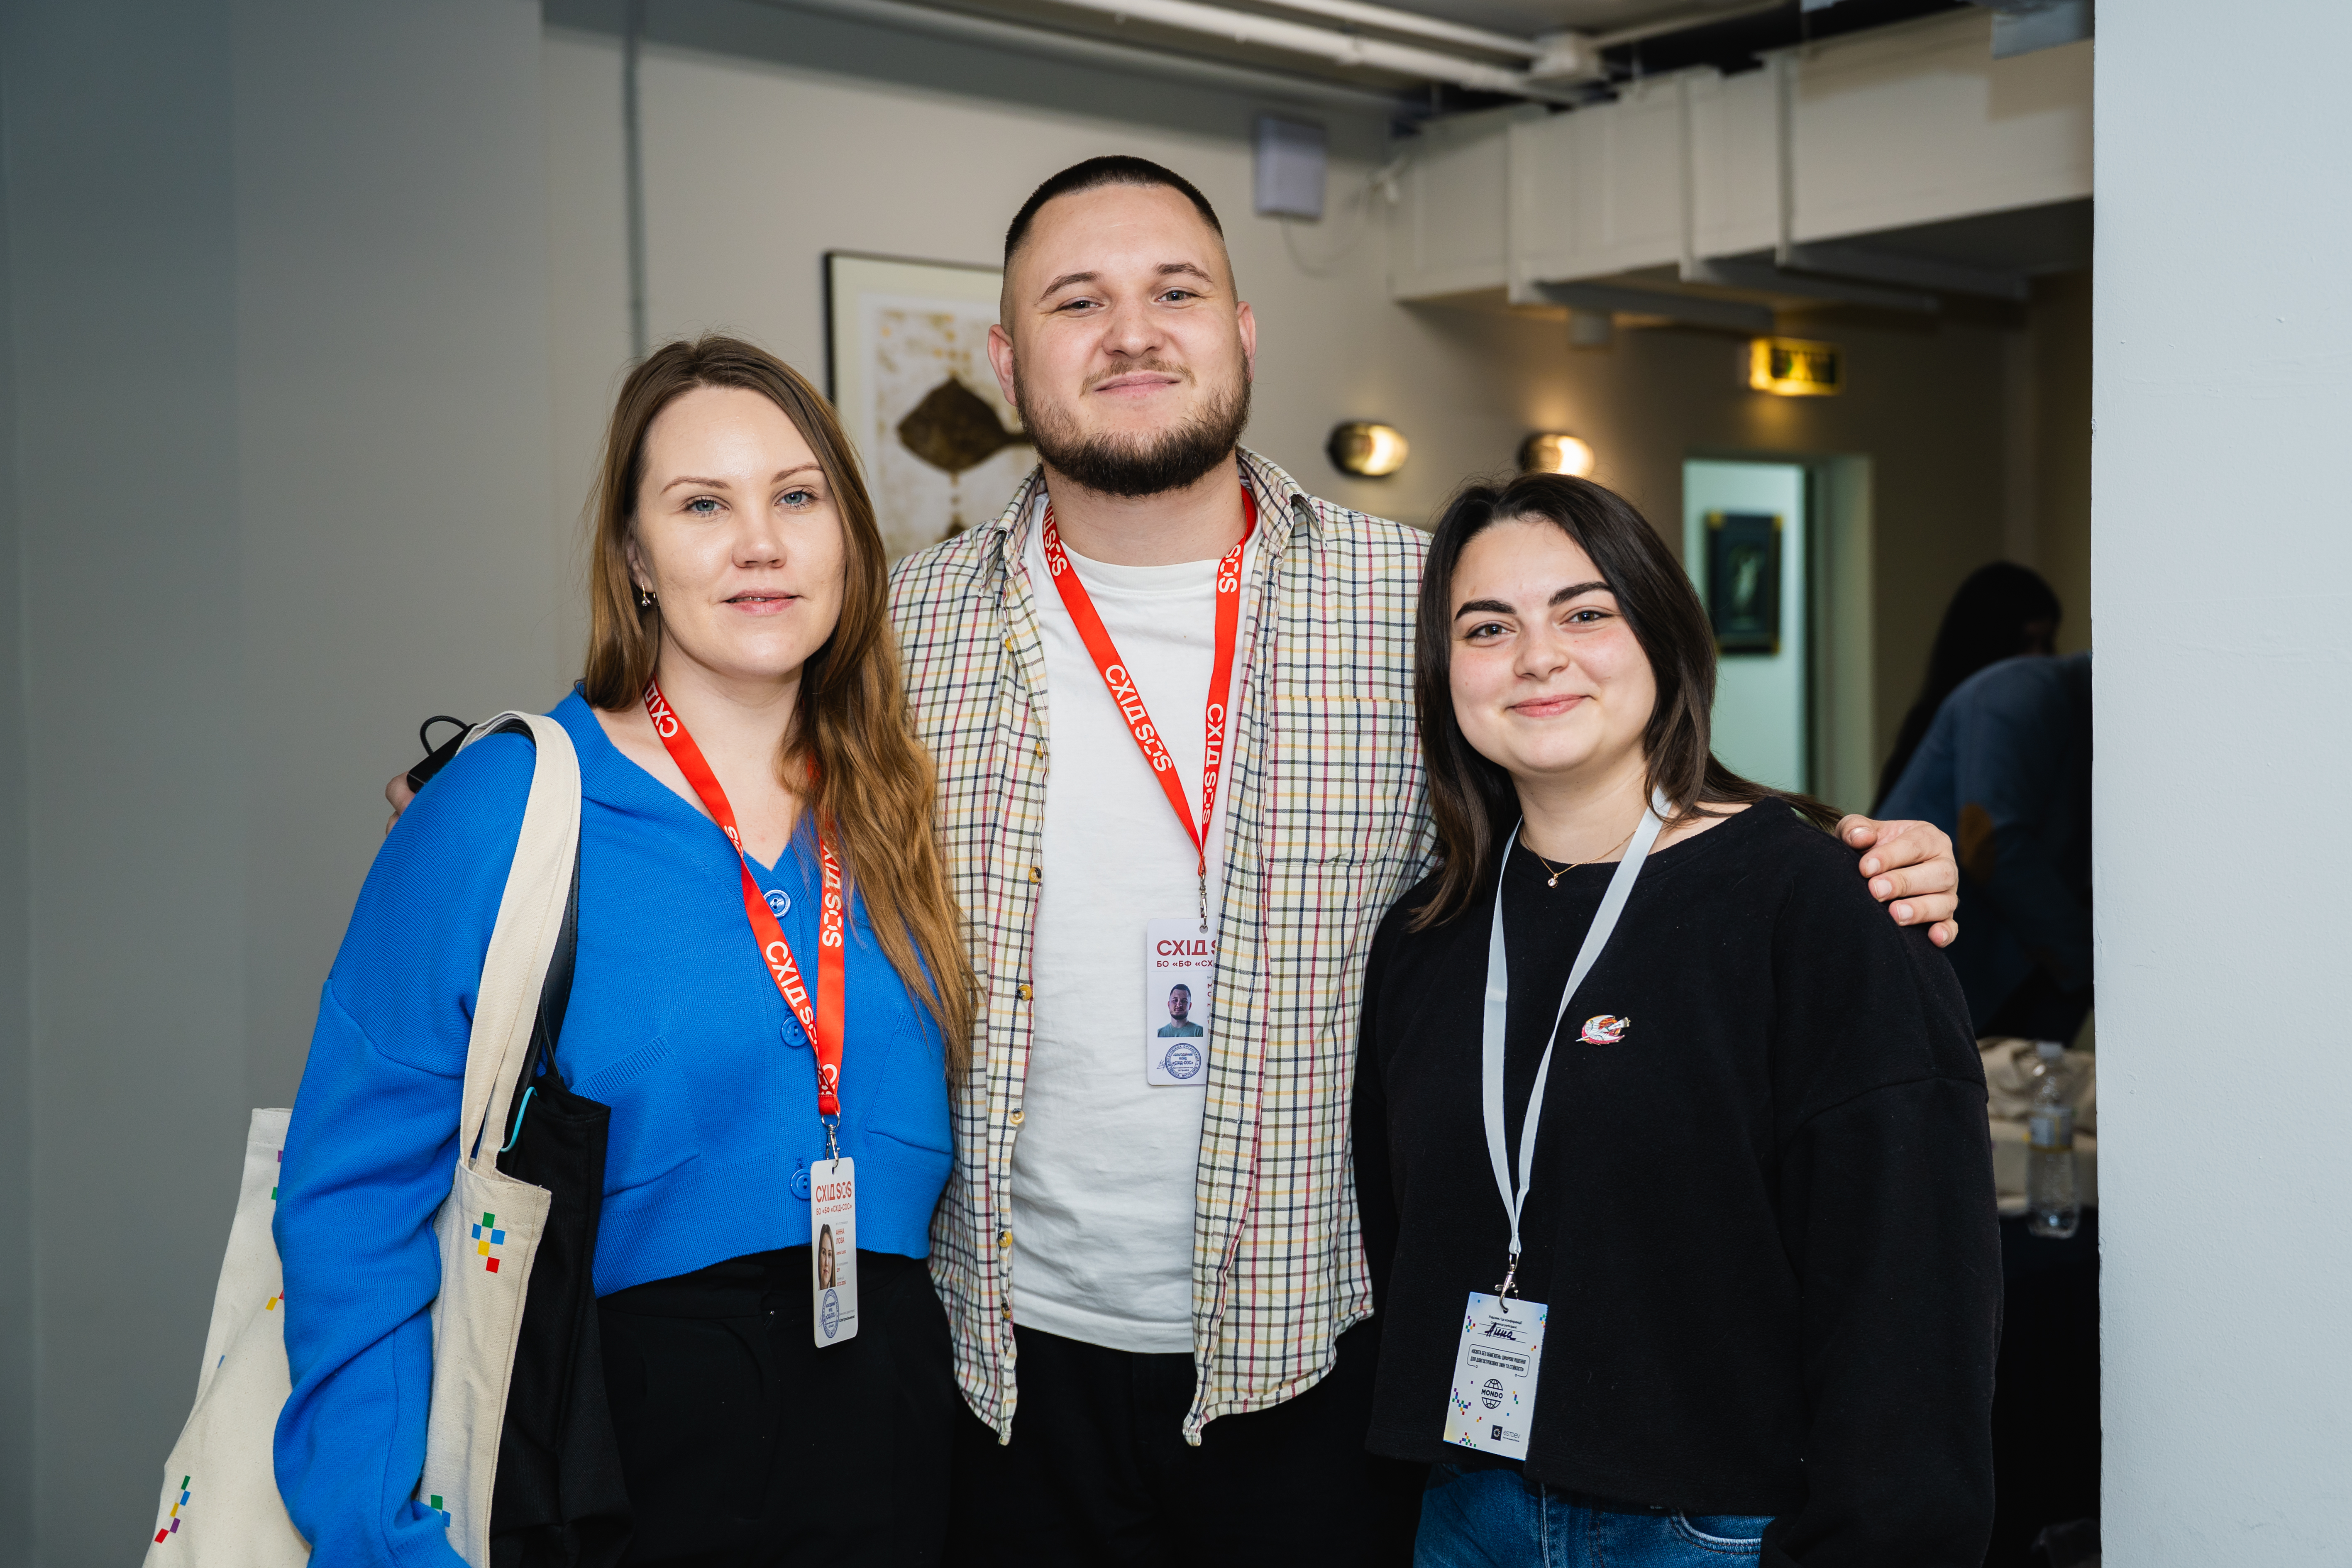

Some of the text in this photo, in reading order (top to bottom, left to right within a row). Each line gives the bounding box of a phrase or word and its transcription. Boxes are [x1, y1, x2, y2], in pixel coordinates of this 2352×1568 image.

[1045, 529, 1067, 576] SOS
[1218, 544, 1241, 593] SOS
[645, 680, 678, 738] СХІД
[1105, 664, 1172, 772] СХІД SOS
[1203, 703, 1224, 825] СХІД SOS
[822, 892, 842, 947] SOS
[766, 941, 807, 1007] СХІД
[1157, 940, 1208, 956] СХІД
[816, 1181, 852, 1203] СХІД SOS
[1481, 1388, 1503, 1399] MONDO
